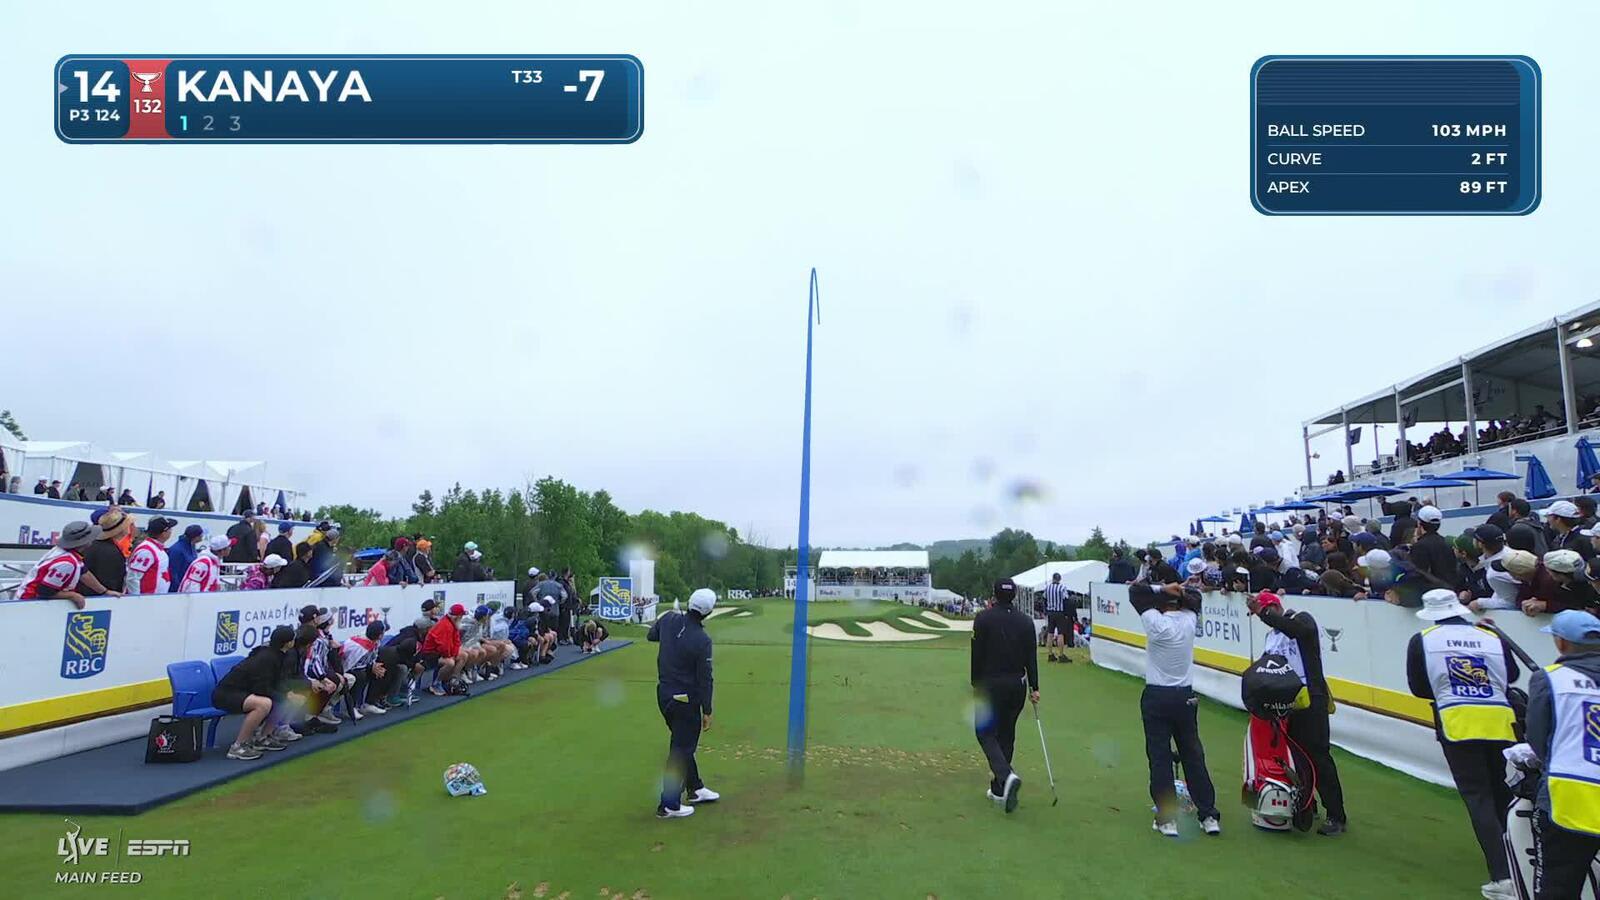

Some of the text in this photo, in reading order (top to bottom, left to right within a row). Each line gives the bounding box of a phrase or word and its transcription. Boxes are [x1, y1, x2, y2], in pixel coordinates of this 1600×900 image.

[603, 607, 630, 616] RBC
[1205, 619, 1241, 643] OPEN
[216, 641, 236, 652] RBC
[65, 657, 103, 675] RBC
[1456, 685, 1492, 697] RBC
